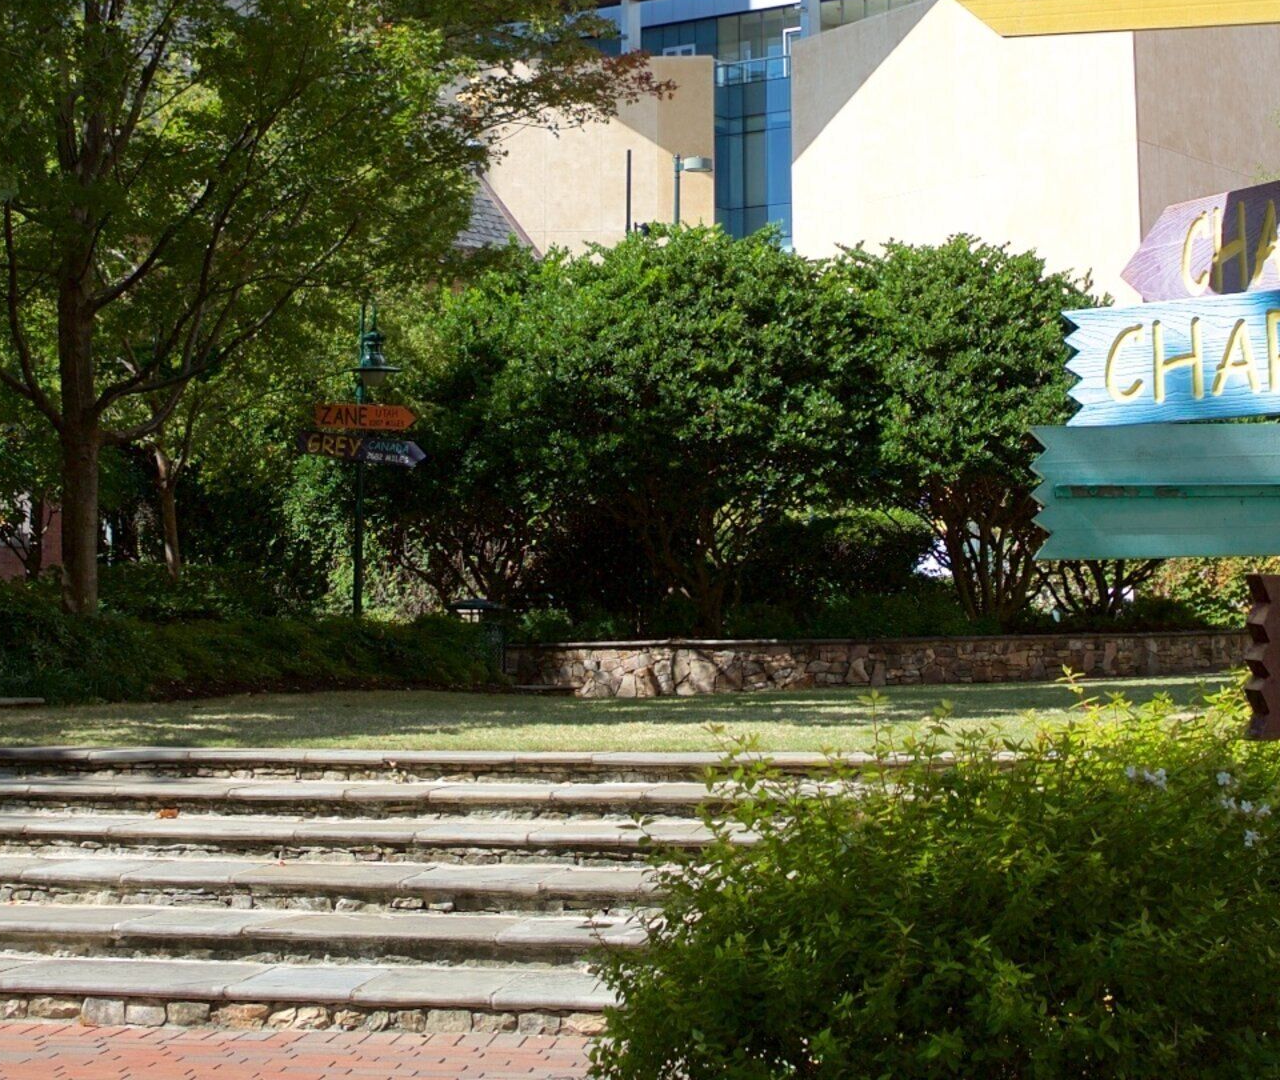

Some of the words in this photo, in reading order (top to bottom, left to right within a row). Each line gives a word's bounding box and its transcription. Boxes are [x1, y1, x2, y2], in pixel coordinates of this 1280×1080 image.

[320, 406, 368, 426] ZANE
[375, 408, 400, 418] UTAH
[306, 434, 364, 458] GREY
[368, 441, 409, 455] CANADA
